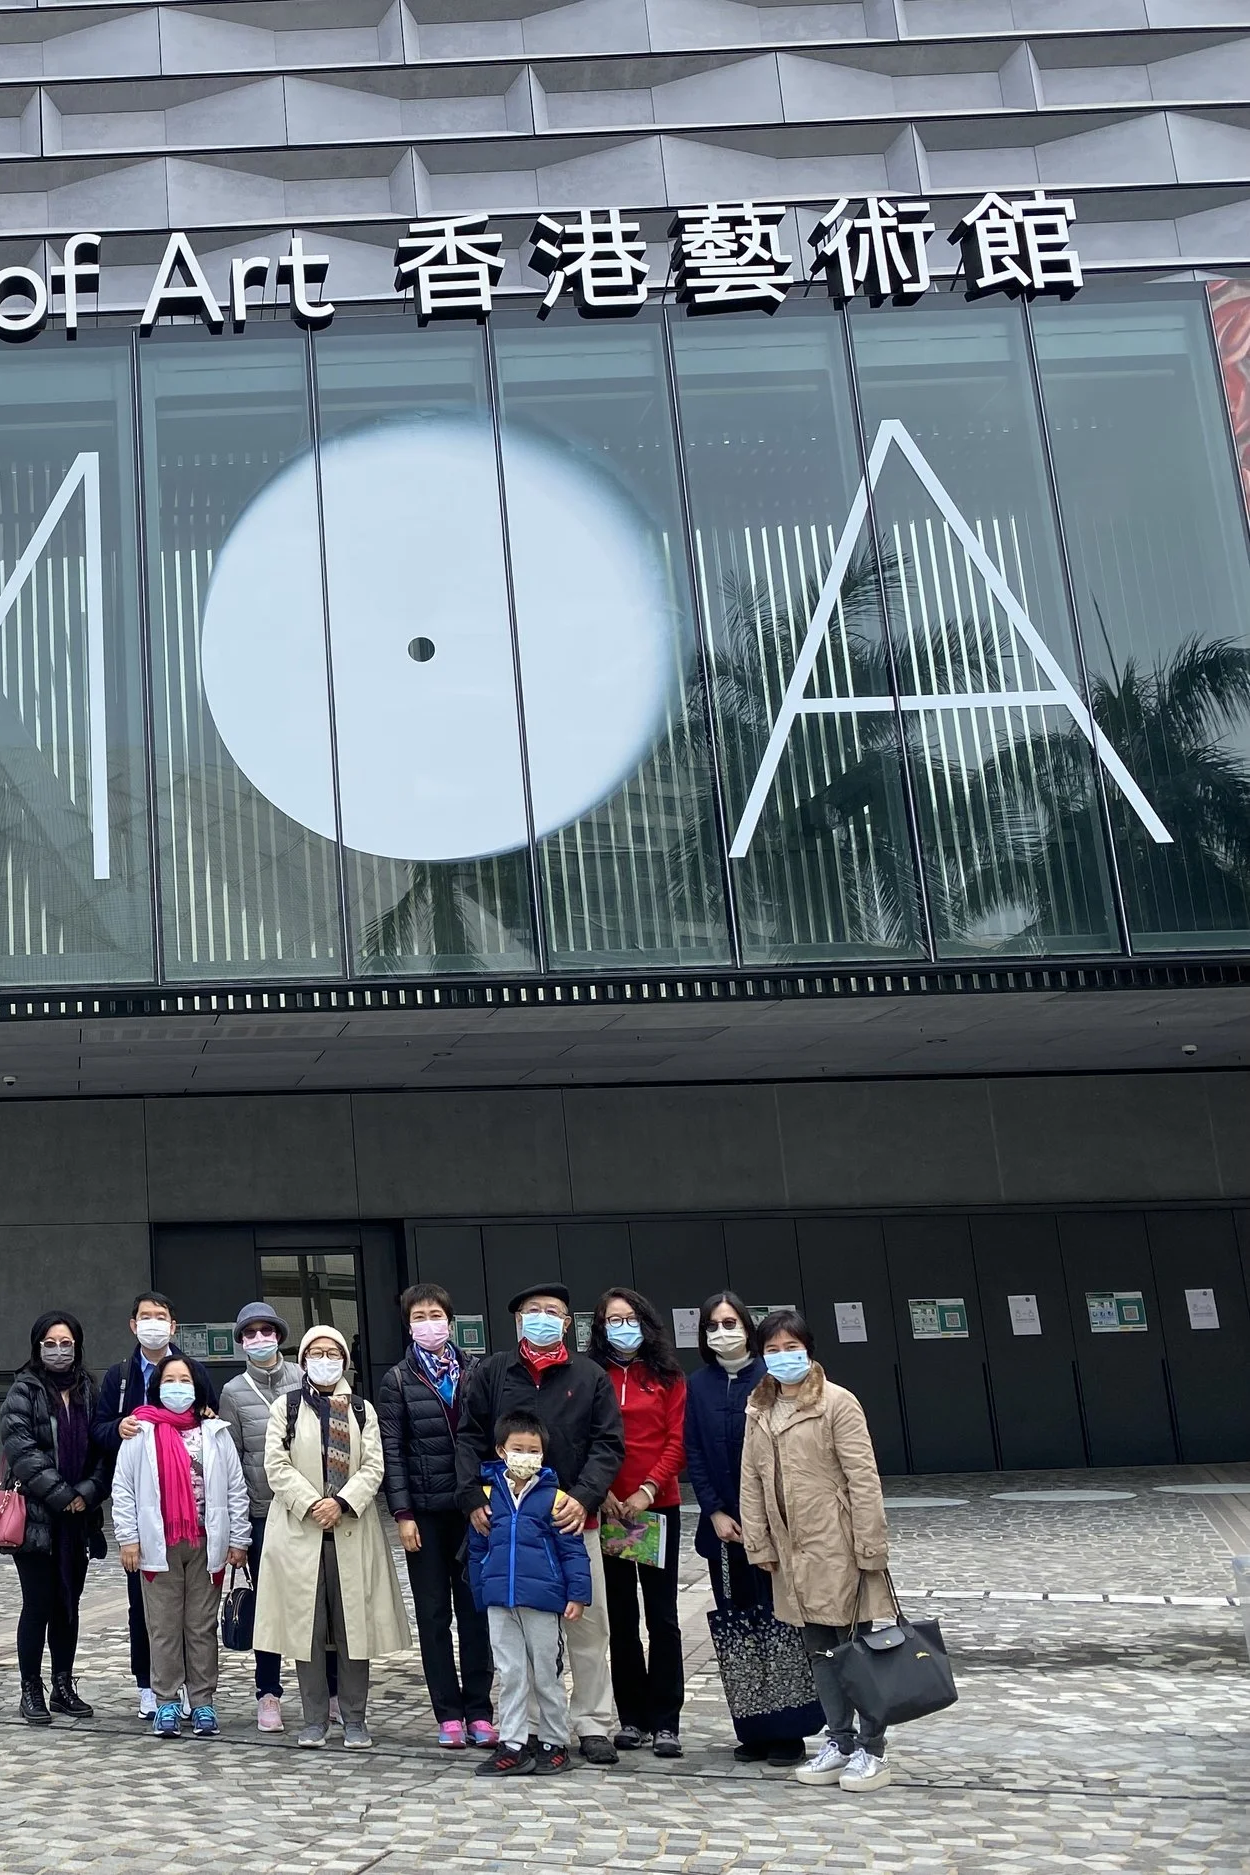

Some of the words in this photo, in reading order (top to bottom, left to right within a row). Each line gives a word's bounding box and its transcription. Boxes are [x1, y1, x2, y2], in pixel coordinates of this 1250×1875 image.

[142, 231, 338, 332] Art
[396, 190, 1085, 317] 香港藝術館
